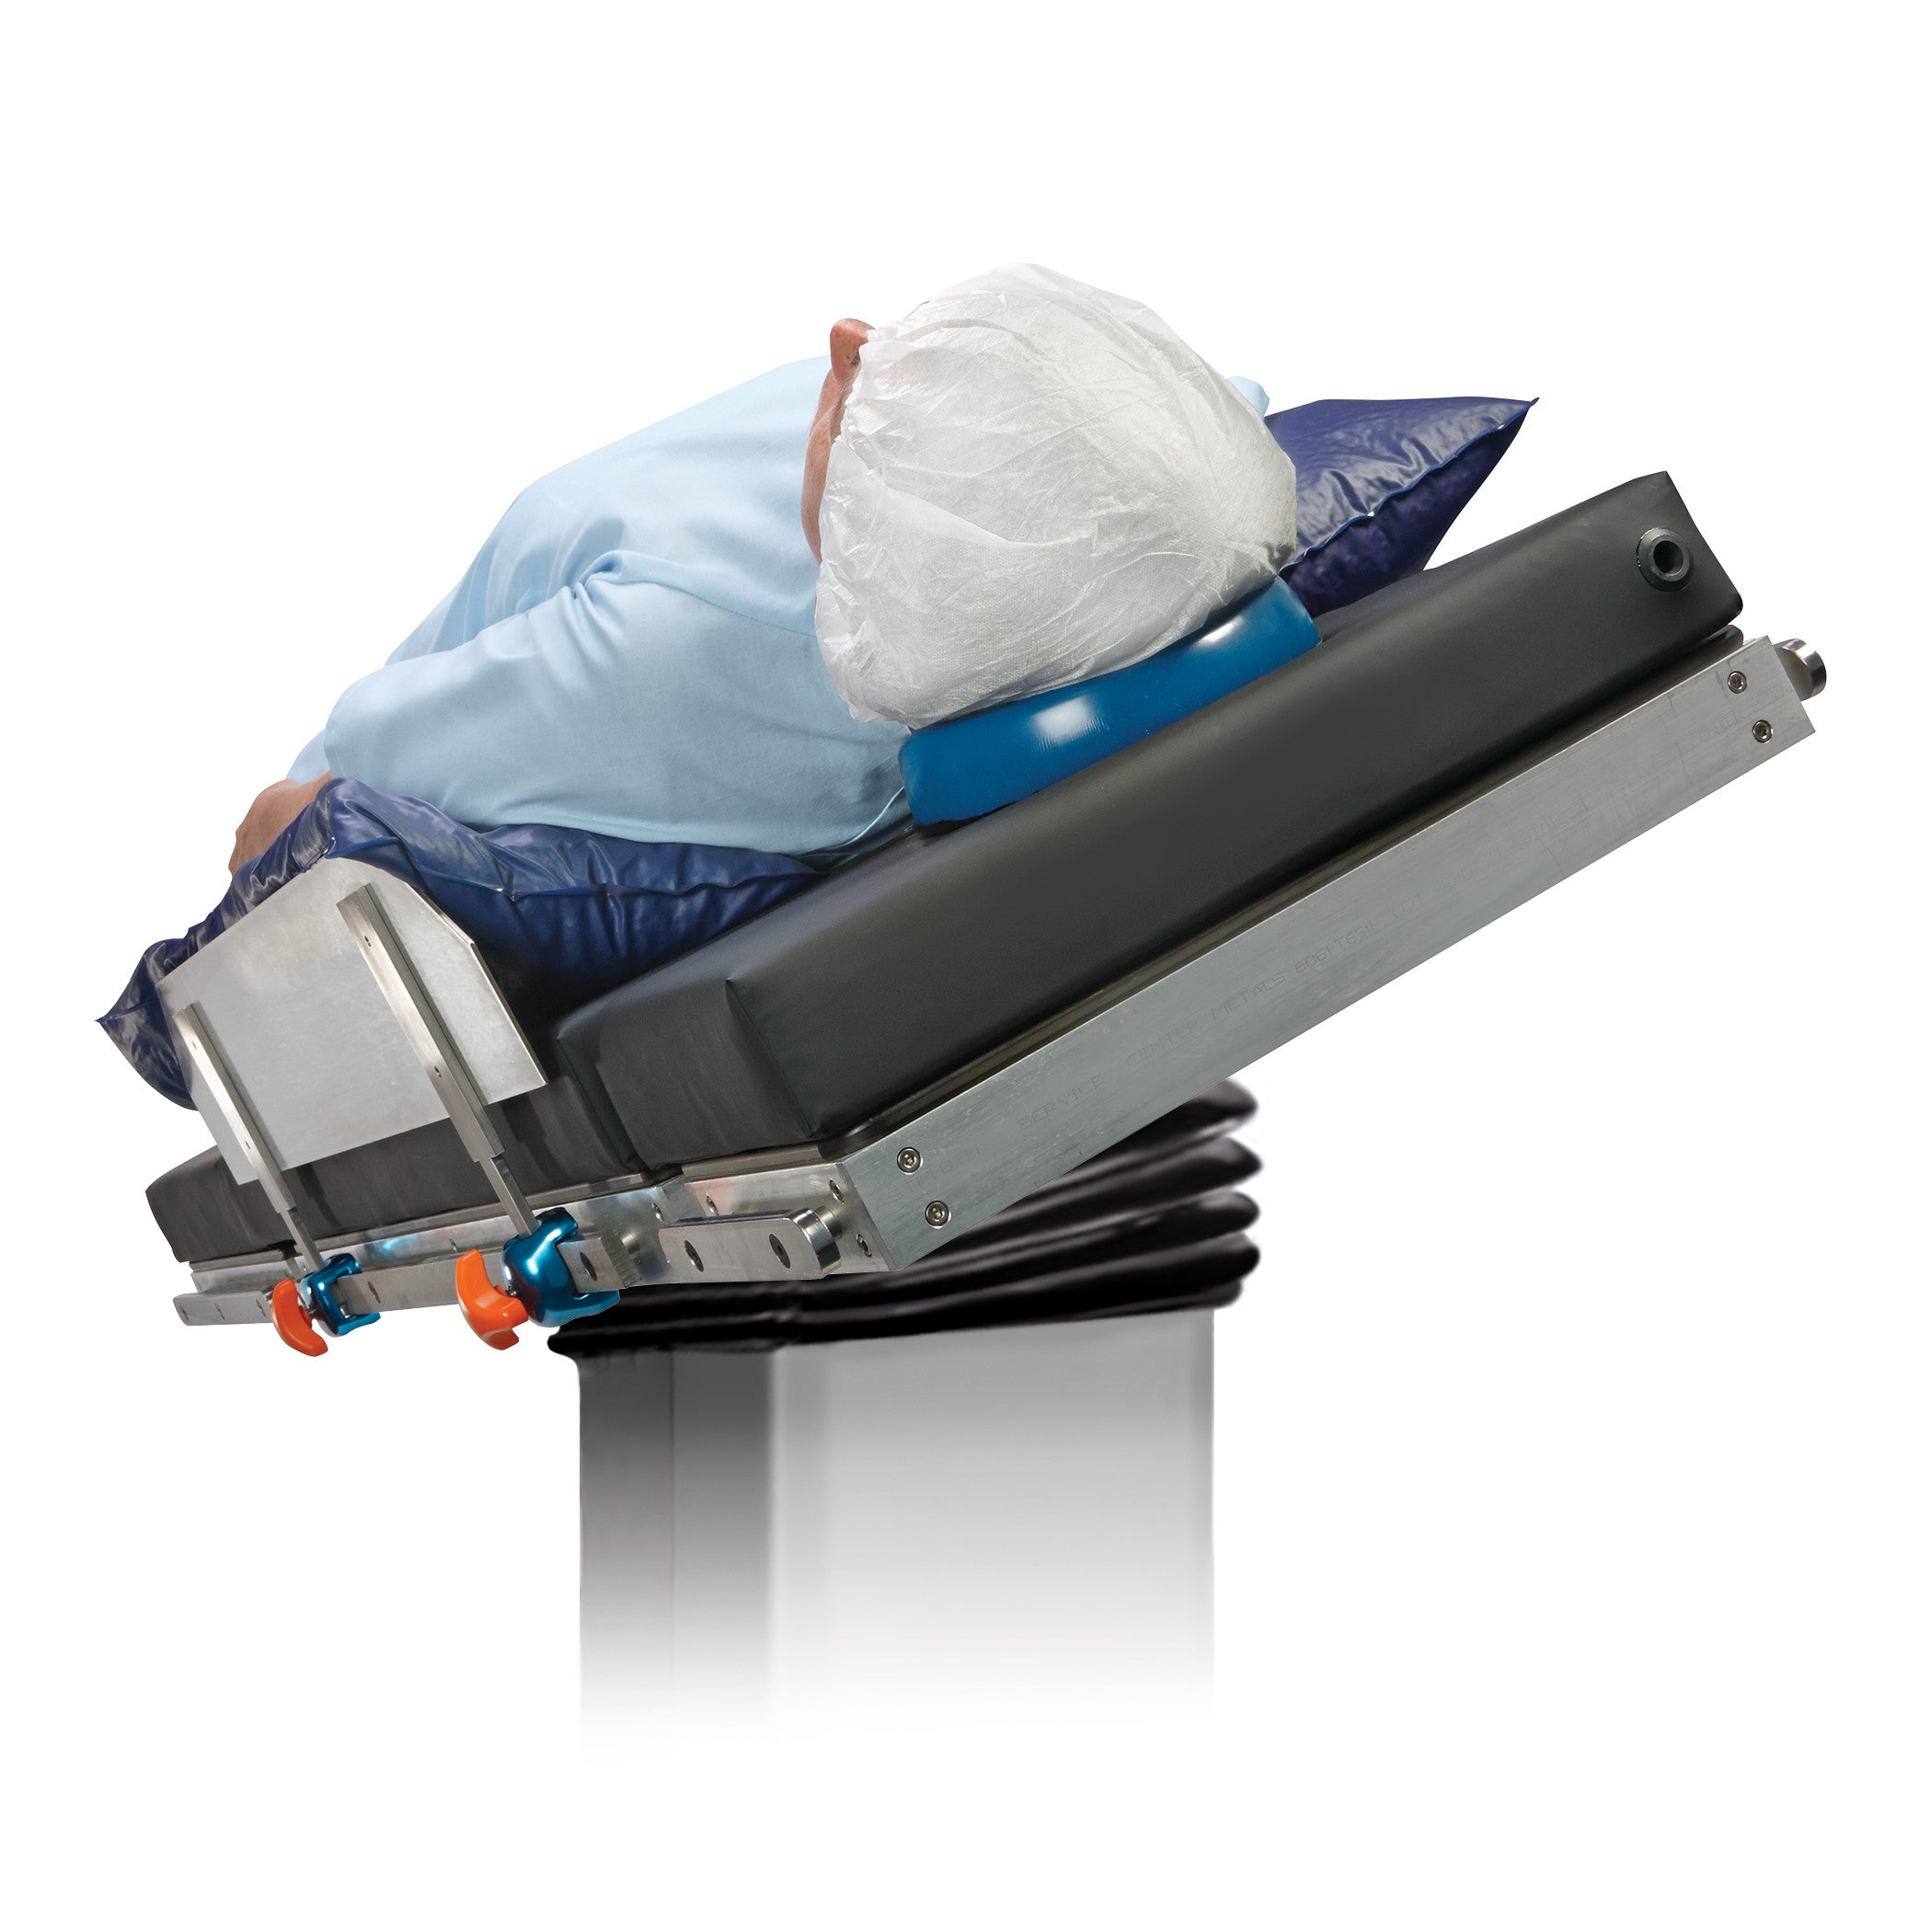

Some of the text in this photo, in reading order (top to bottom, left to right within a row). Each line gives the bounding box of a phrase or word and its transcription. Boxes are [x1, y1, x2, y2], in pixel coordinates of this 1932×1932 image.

[1016, 1072, 1106, 1132] SERVICE
[1123, 1017, 1202, 1069] CENTER
[1208, 969, 1287, 1022] METALS
